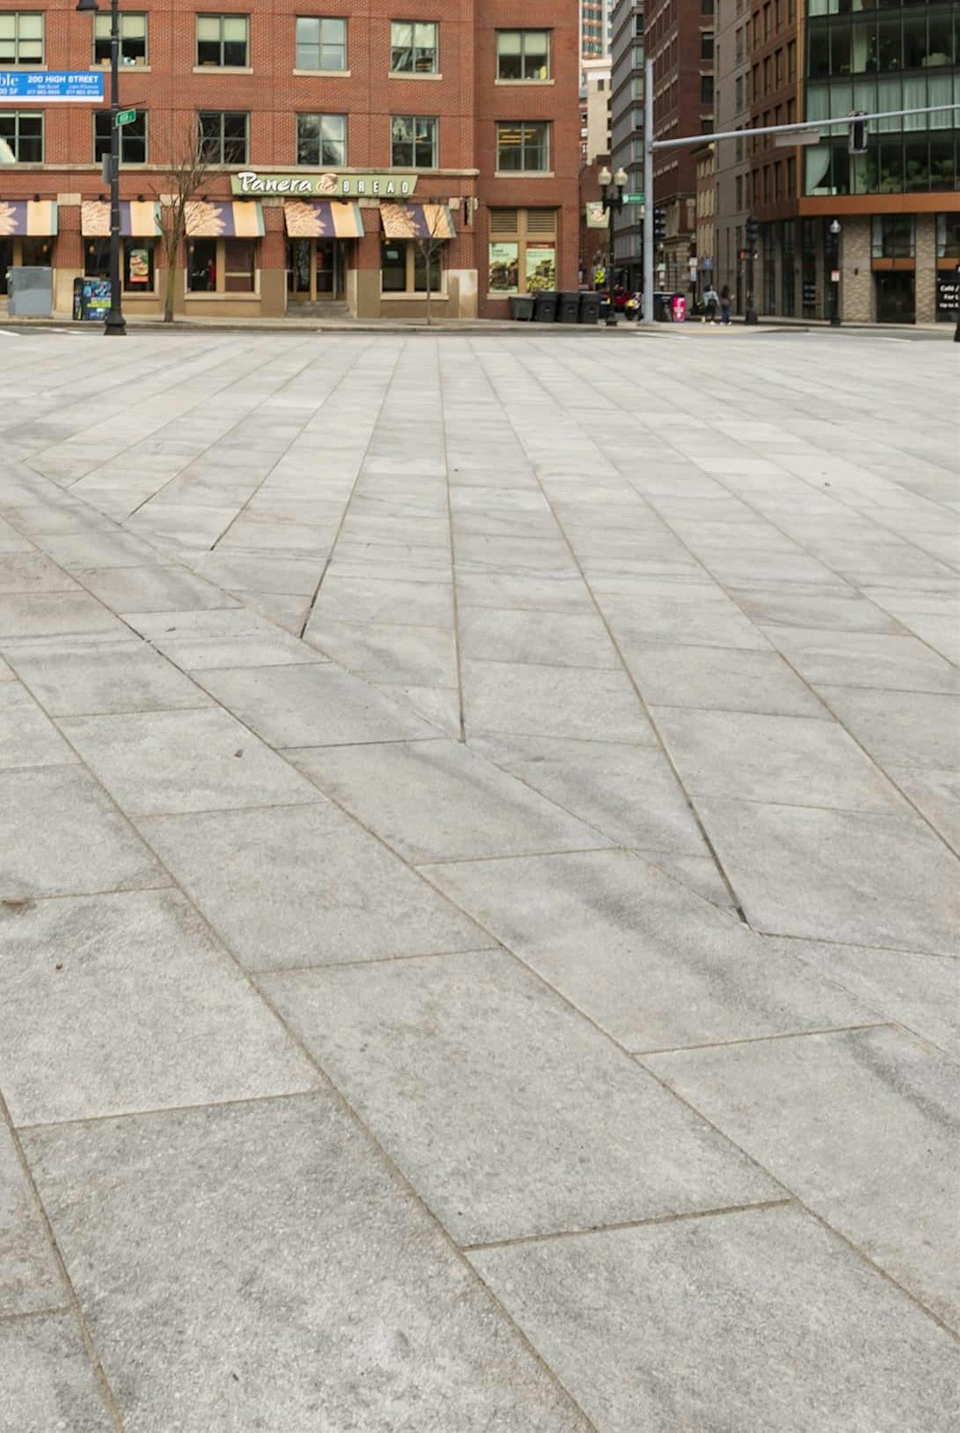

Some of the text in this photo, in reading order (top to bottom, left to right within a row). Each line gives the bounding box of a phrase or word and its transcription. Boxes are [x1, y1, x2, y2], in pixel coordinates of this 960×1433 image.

[27, 75, 99, 84] 200 HIGH STREET
[237, 171, 409, 194] Panera BREAD
